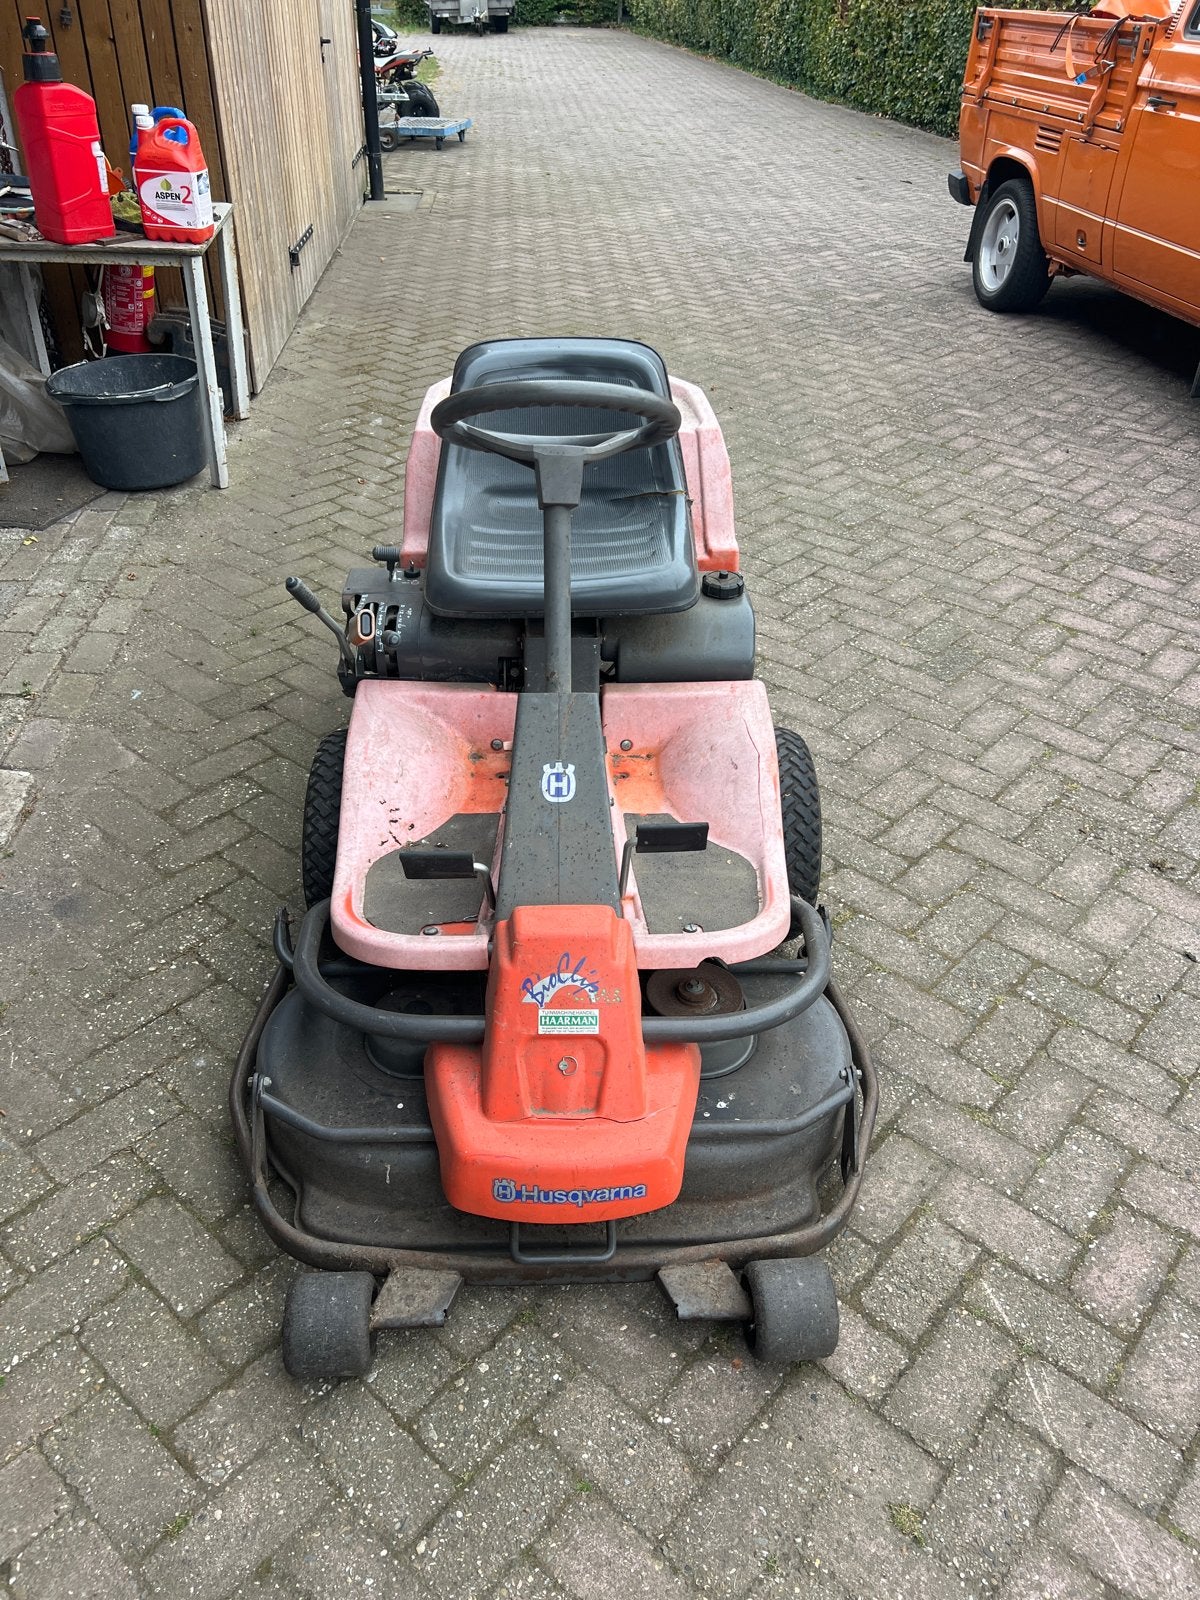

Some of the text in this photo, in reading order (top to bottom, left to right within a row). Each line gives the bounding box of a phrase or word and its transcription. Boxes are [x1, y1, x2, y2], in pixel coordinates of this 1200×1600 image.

[155, 185, 193, 205] ASPEN 2
[521, 951, 600, 1009] BioClip
[541, 1016, 597, 1025] HAARMAN
[521, 1184, 647, 1207] Husqvarna
